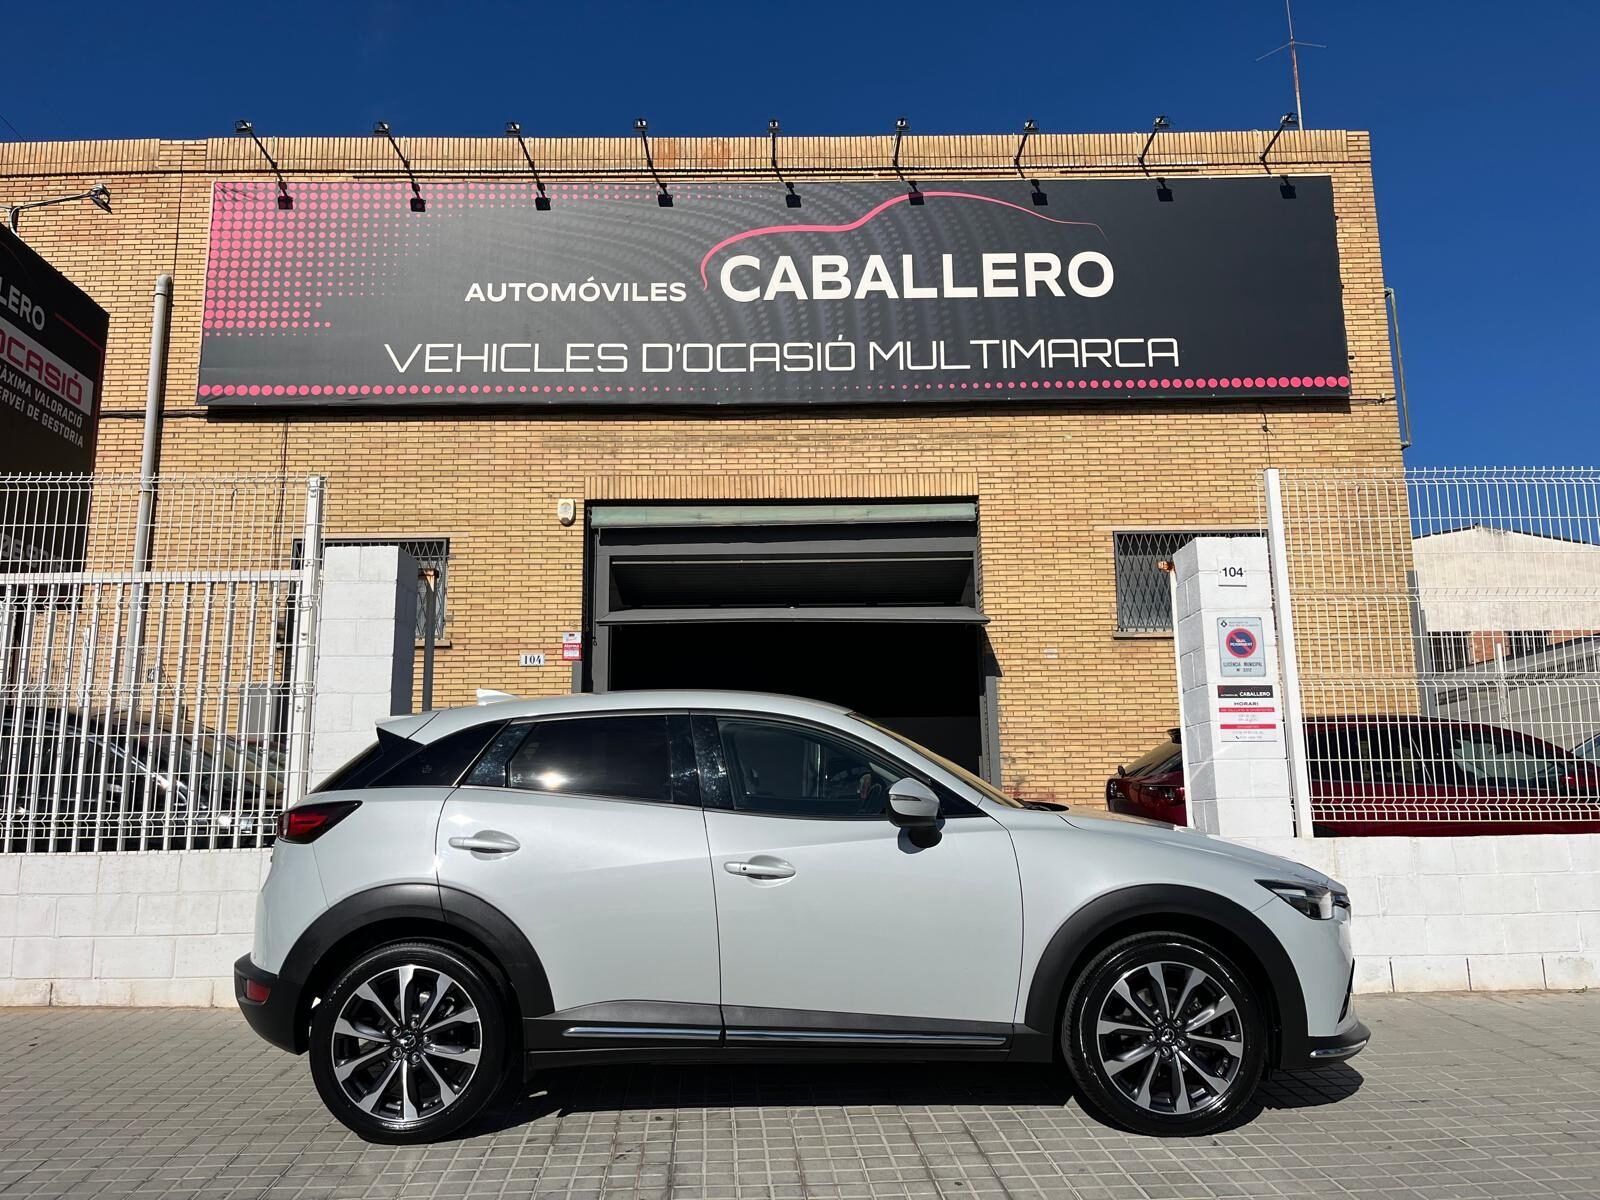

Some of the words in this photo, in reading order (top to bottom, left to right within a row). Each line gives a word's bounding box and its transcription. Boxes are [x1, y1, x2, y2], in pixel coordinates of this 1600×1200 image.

[464, 276, 687, 303] AUTOMÓVILES
[719, 251, 1115, 303] CABALLERO
[384, 342, 628, 374] VEHICLES
[642, 334, 856, 373] D'OCASIÓ
[26, 404, 41, 421] DE
[41, 412, 84, 448] GESTORIA
[34, 387, 83, 429] VALORACIÓ
[1222, 567, 1244, 578] 104
[524, 655, 541, 664] 104
